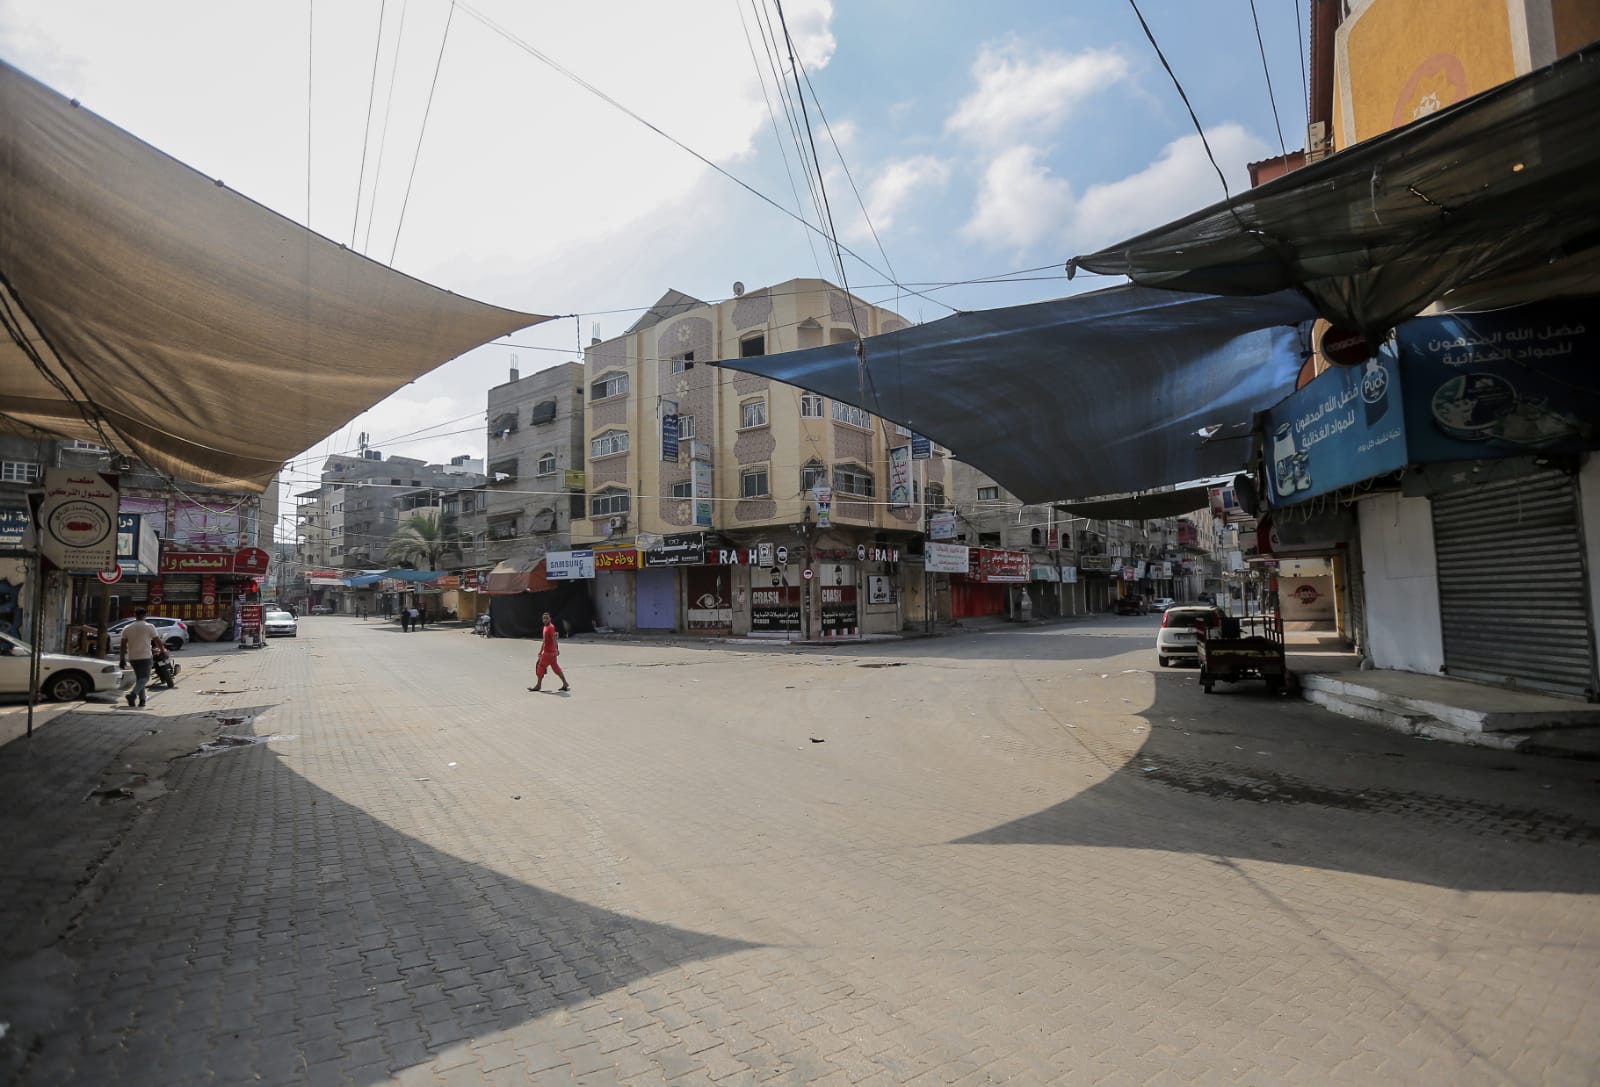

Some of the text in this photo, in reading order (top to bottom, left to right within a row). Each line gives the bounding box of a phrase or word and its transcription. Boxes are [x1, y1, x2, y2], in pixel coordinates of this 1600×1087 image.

[1428, 321, 1586, 353] فضل الله المدهون
[1442, 341, 1573, 367] للمواد الغذائية
[1295, 383, 1359, 433] فضل الله المدهون
[1302, 409, 1355, 449] للمواد الغذائية
[179, 556, 227, 569] المطعم
[550, 559, 585, 569] SAMSUNG
